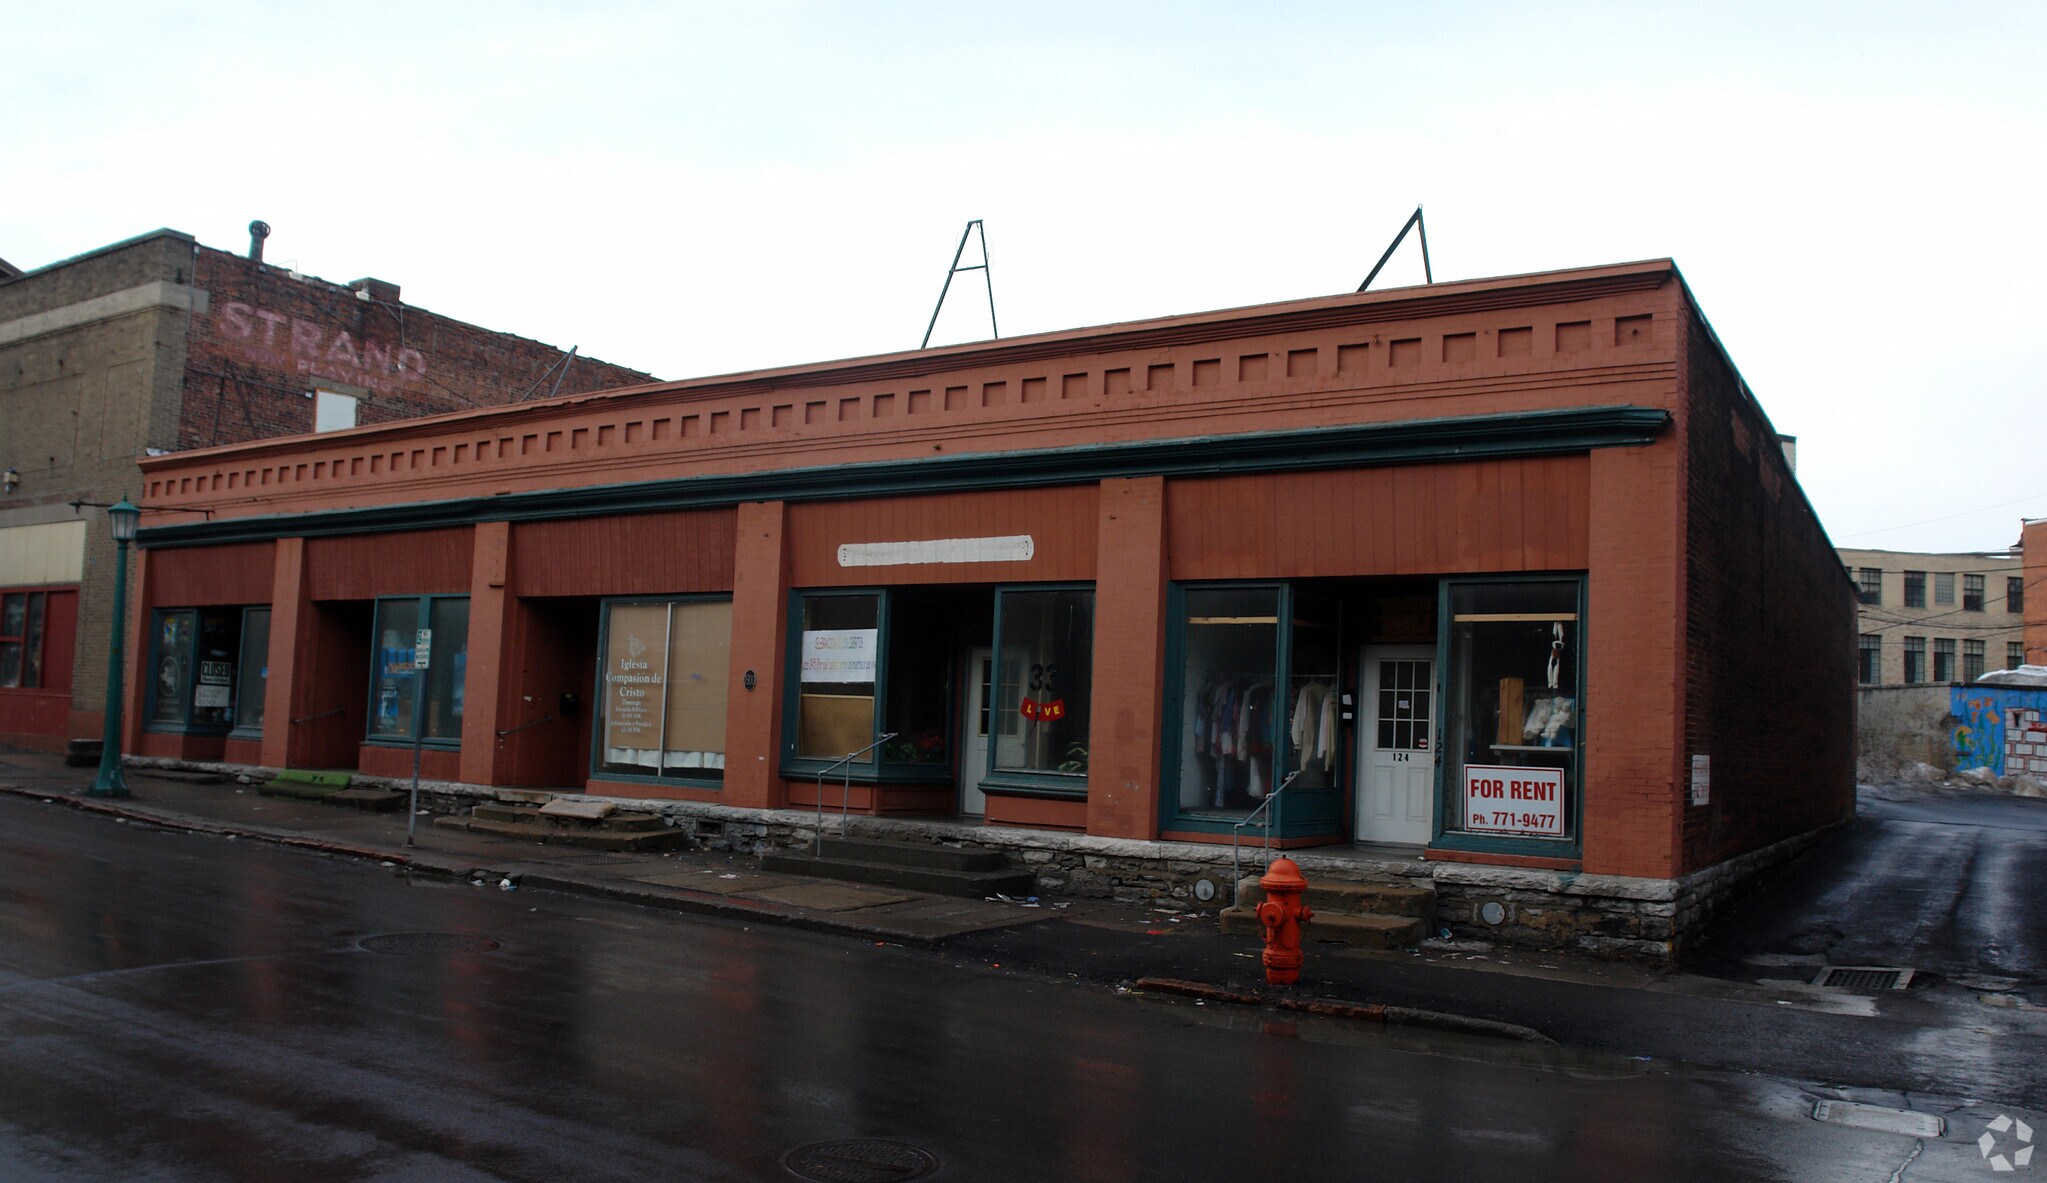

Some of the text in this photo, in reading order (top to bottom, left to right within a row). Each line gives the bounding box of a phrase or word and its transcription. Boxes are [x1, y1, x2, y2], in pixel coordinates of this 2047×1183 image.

[220, 302, 427, 381] STRAND
[297, 359, 393, 392] PLAYING
[202, 662, 230, 677] CLOSED
[621, 659, 647, 670] Iglesia
[605, 671, 662, 684] Compasión de
[1030, 664, 1056, 691] 33
[619, 686, 645, 697] Cristo
[1392, 753, 1409, 762] 124
[1470, 779, 1557, 801] FOR RENT
[1473, 811, 1555, 829] Ph. 771-9477
